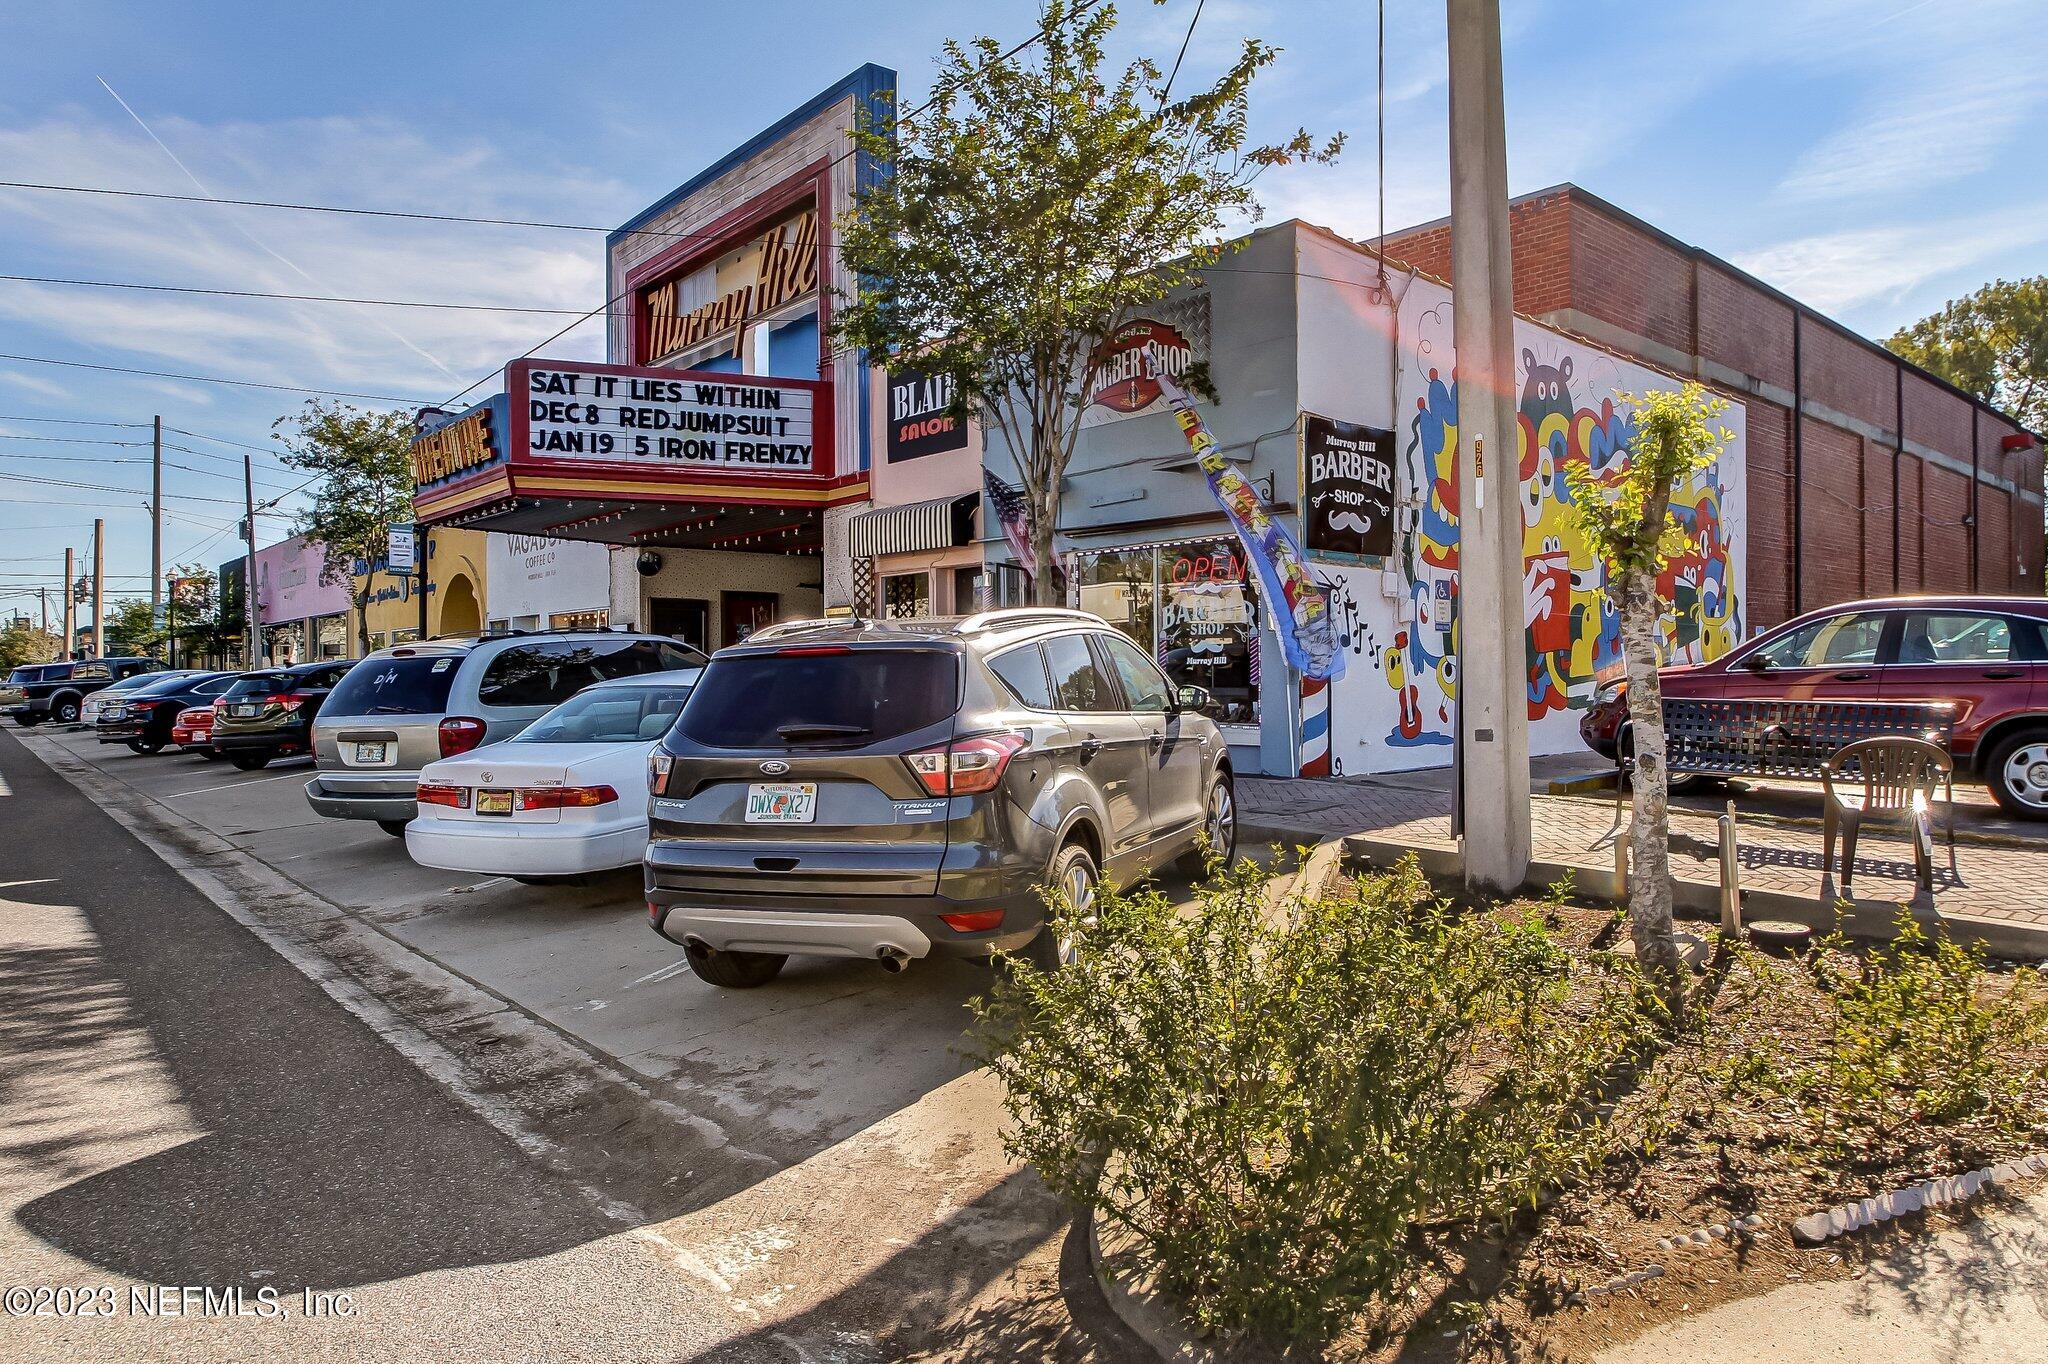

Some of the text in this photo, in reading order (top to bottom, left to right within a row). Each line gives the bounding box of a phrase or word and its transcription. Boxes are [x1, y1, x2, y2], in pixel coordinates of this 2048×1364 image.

[648, 211, 819, 359] Murray Hill
[531, 371, 780, 410] SAT IT LIES WITHIN
[531, 400, 579, 423] DEC
[585, 404, 600, 425] 8
[900, 416, 955, 442] SALON
[531, 430, 812, 465] JAN 19 5 IRON FRENZY
[1326, 435, 1376, 452] Murray Hill
[1311, 450, 1392, 493] BARBER
[1475, 440, 1483, 477] 926
[525, 554, 546, 569] COFFEE
[1173, 555, 1249, 583] OPEN
[1187, 656, 1227, 666] Murray Hill
[750, 795, 811, 814] DWX X27
[892, 801, 947, 809] TITANIUM
